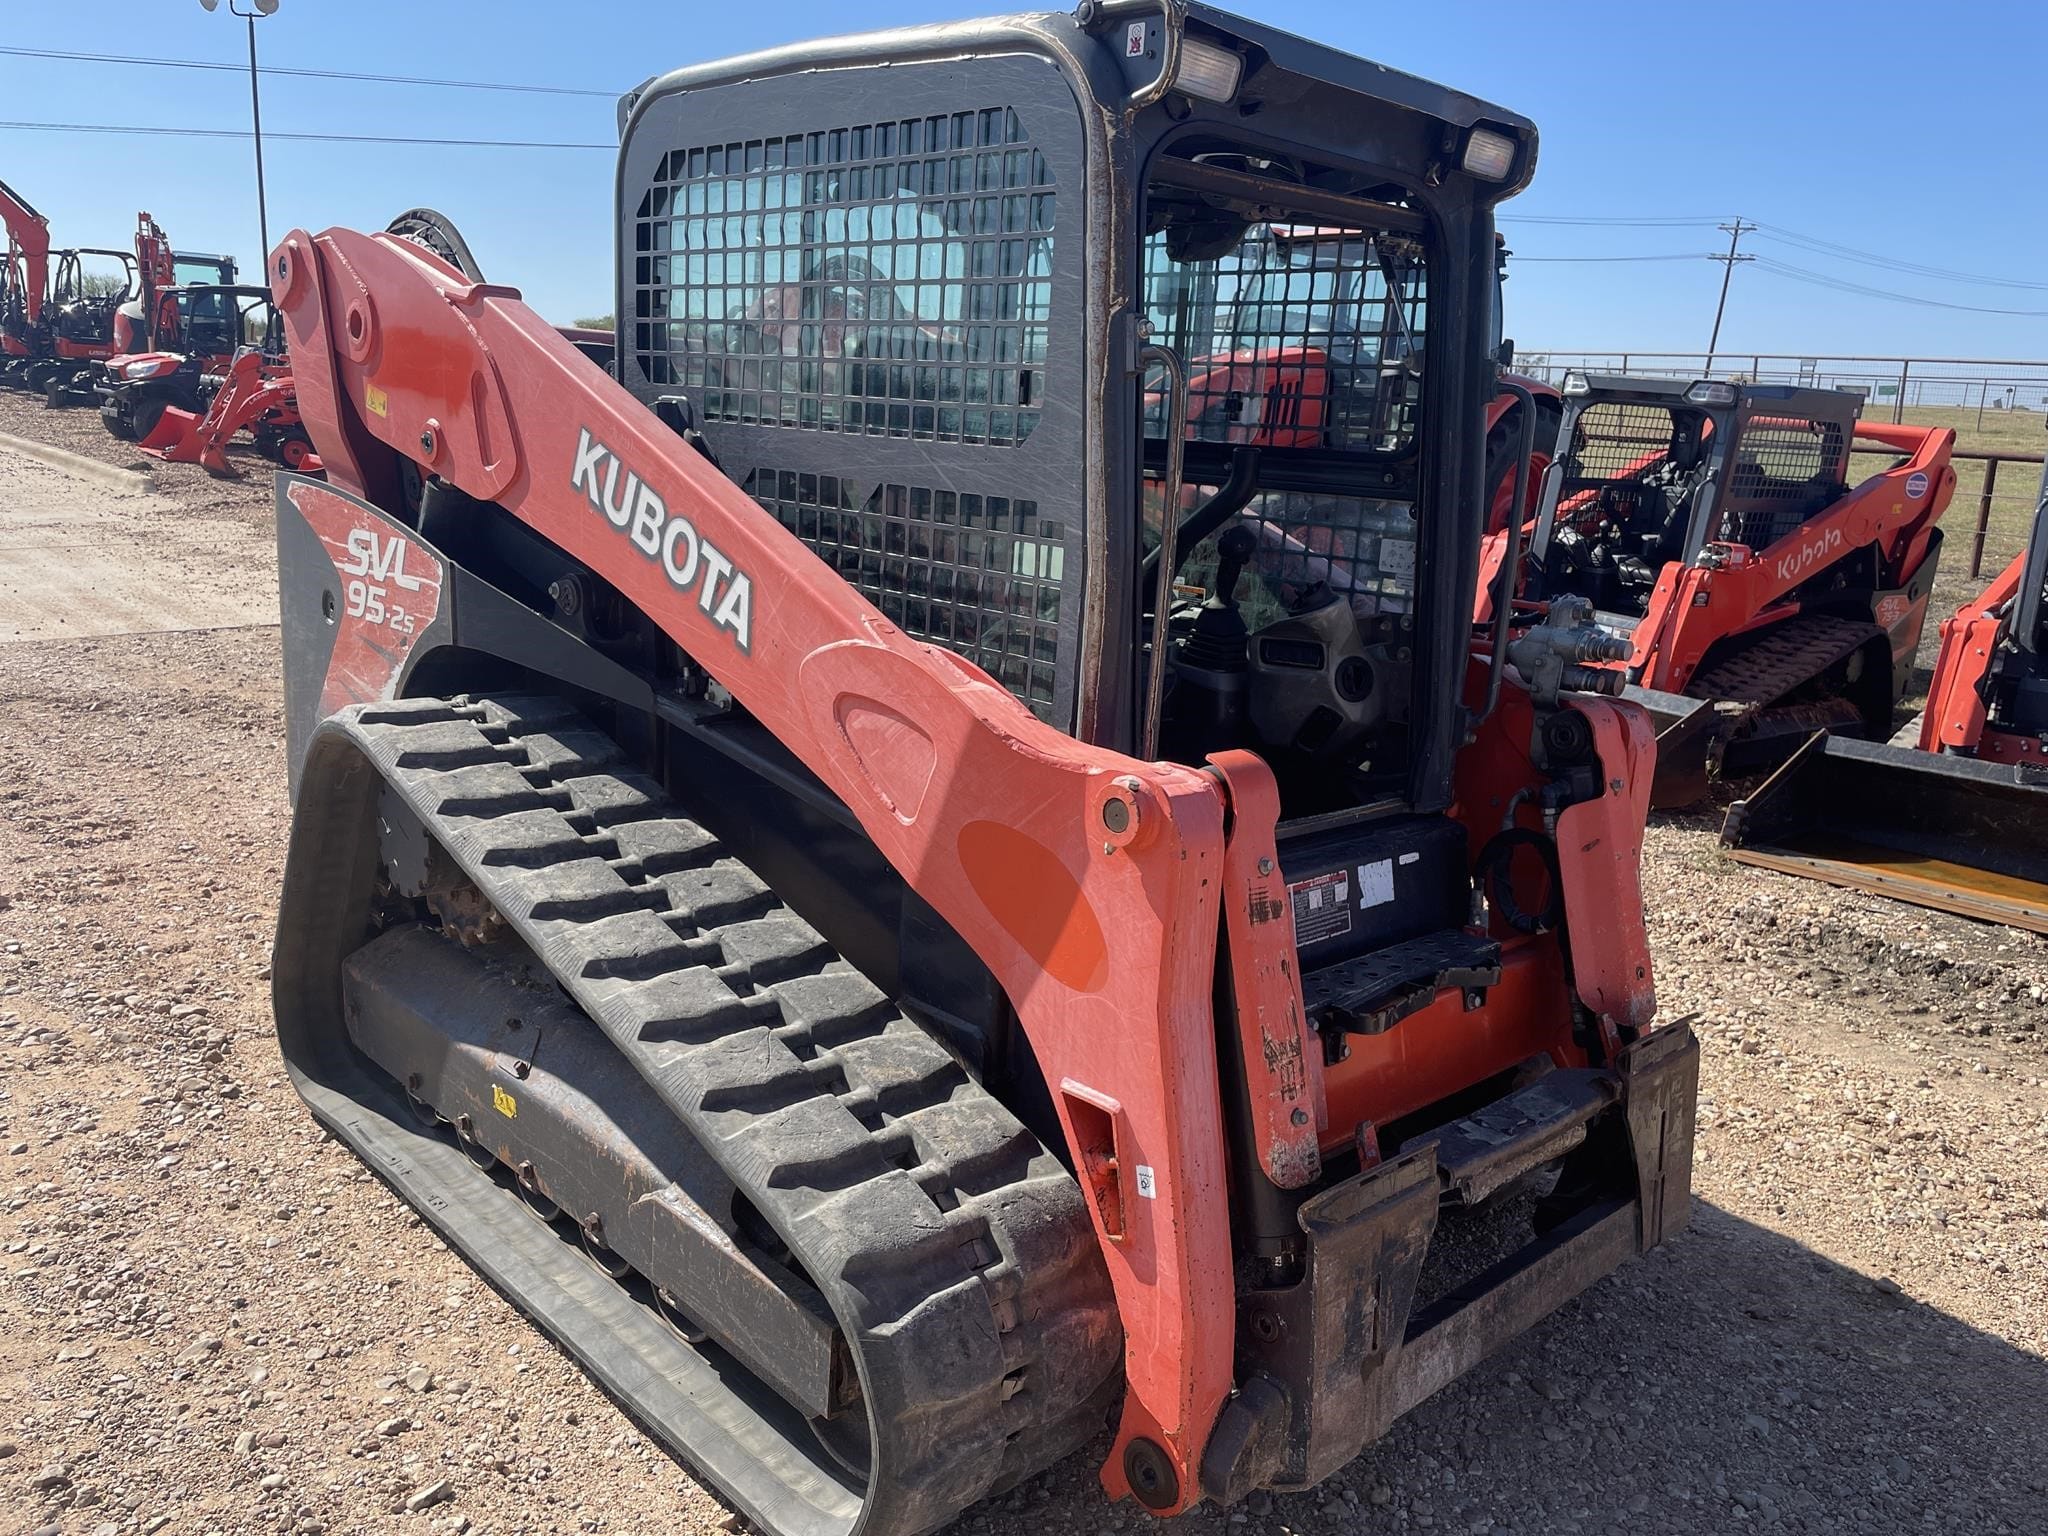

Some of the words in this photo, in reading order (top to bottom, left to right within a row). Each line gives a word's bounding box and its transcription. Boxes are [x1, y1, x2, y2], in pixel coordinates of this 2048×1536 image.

[344, 528, 420, 592] SVL
[570, 426, 752, 650] KUBOTA
[1777, 527, 1841, 581] Kubota
[1880, 599, 1900, 611] SVL
